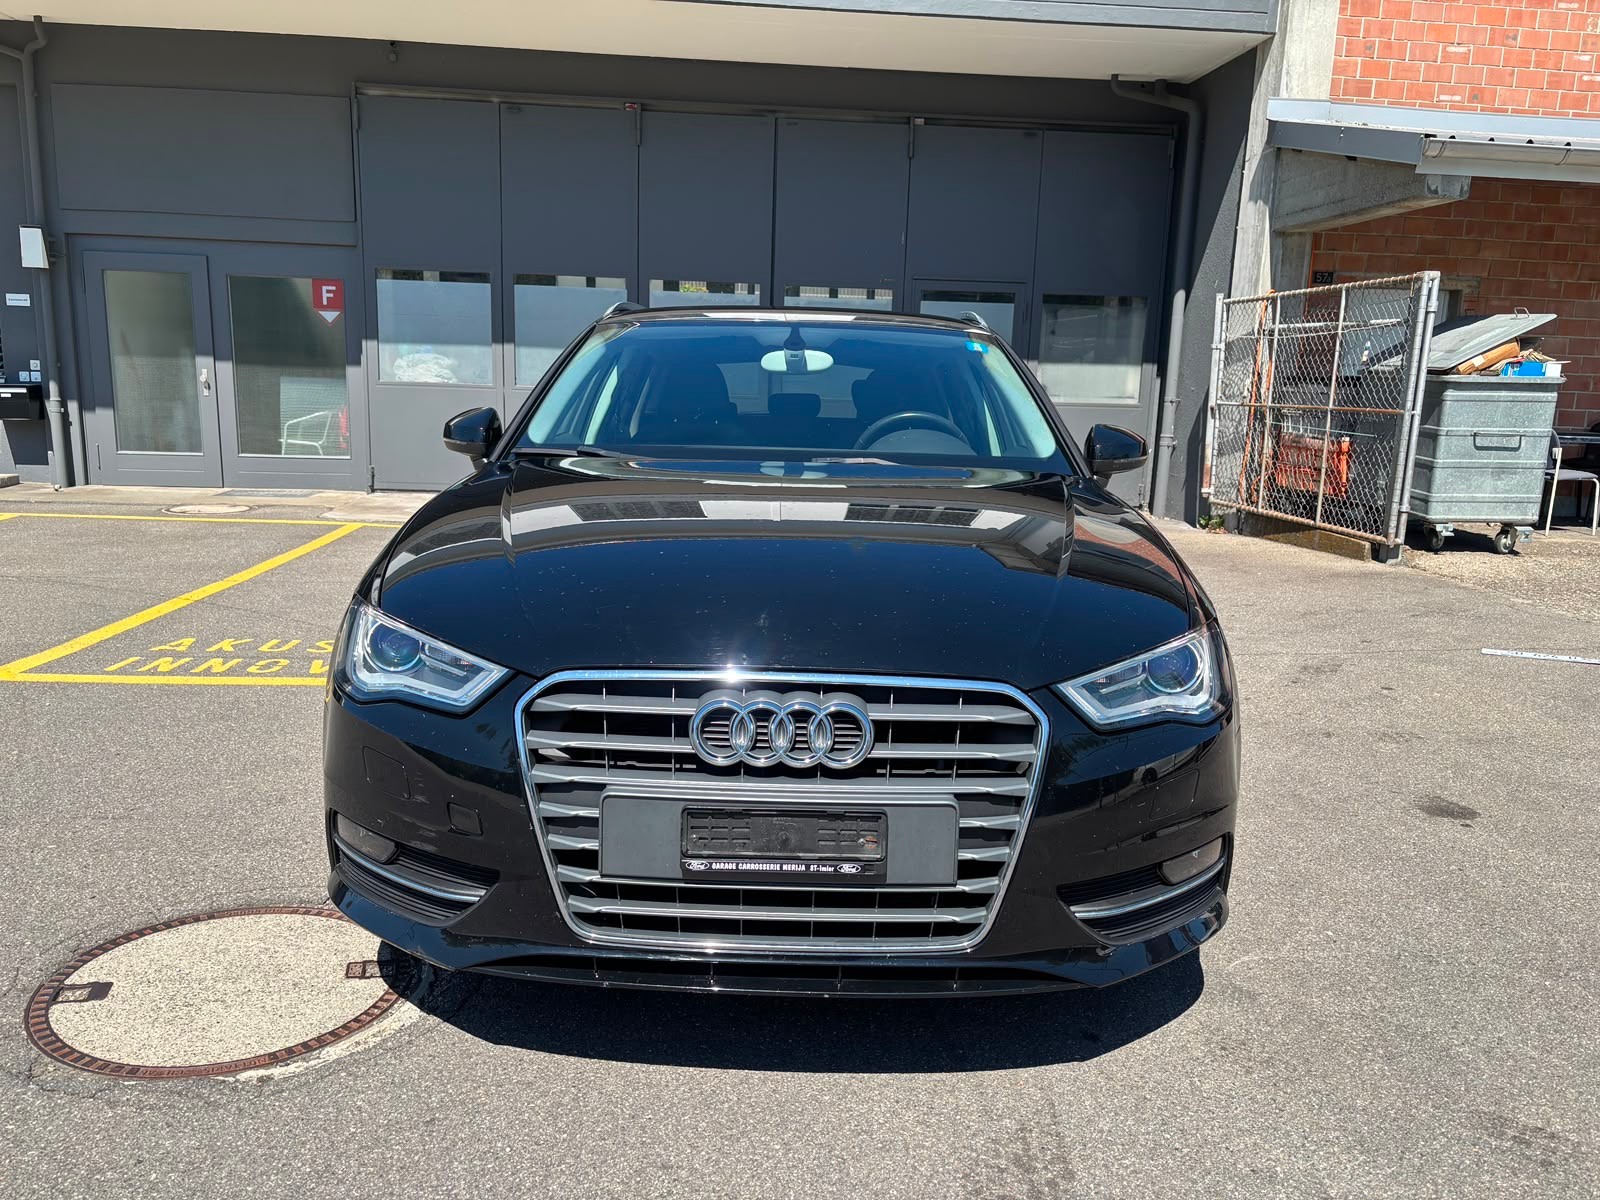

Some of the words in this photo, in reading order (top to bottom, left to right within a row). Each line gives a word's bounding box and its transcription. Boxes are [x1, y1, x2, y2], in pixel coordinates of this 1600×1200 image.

[321, 285, 337, 306] F
[687, 861, 709, 870] Ford
[711, 862, 737, 870] GARAGE
[738, 862, 781, 871] CARROSSERIE
[838, 863, 860, 873] Ford
